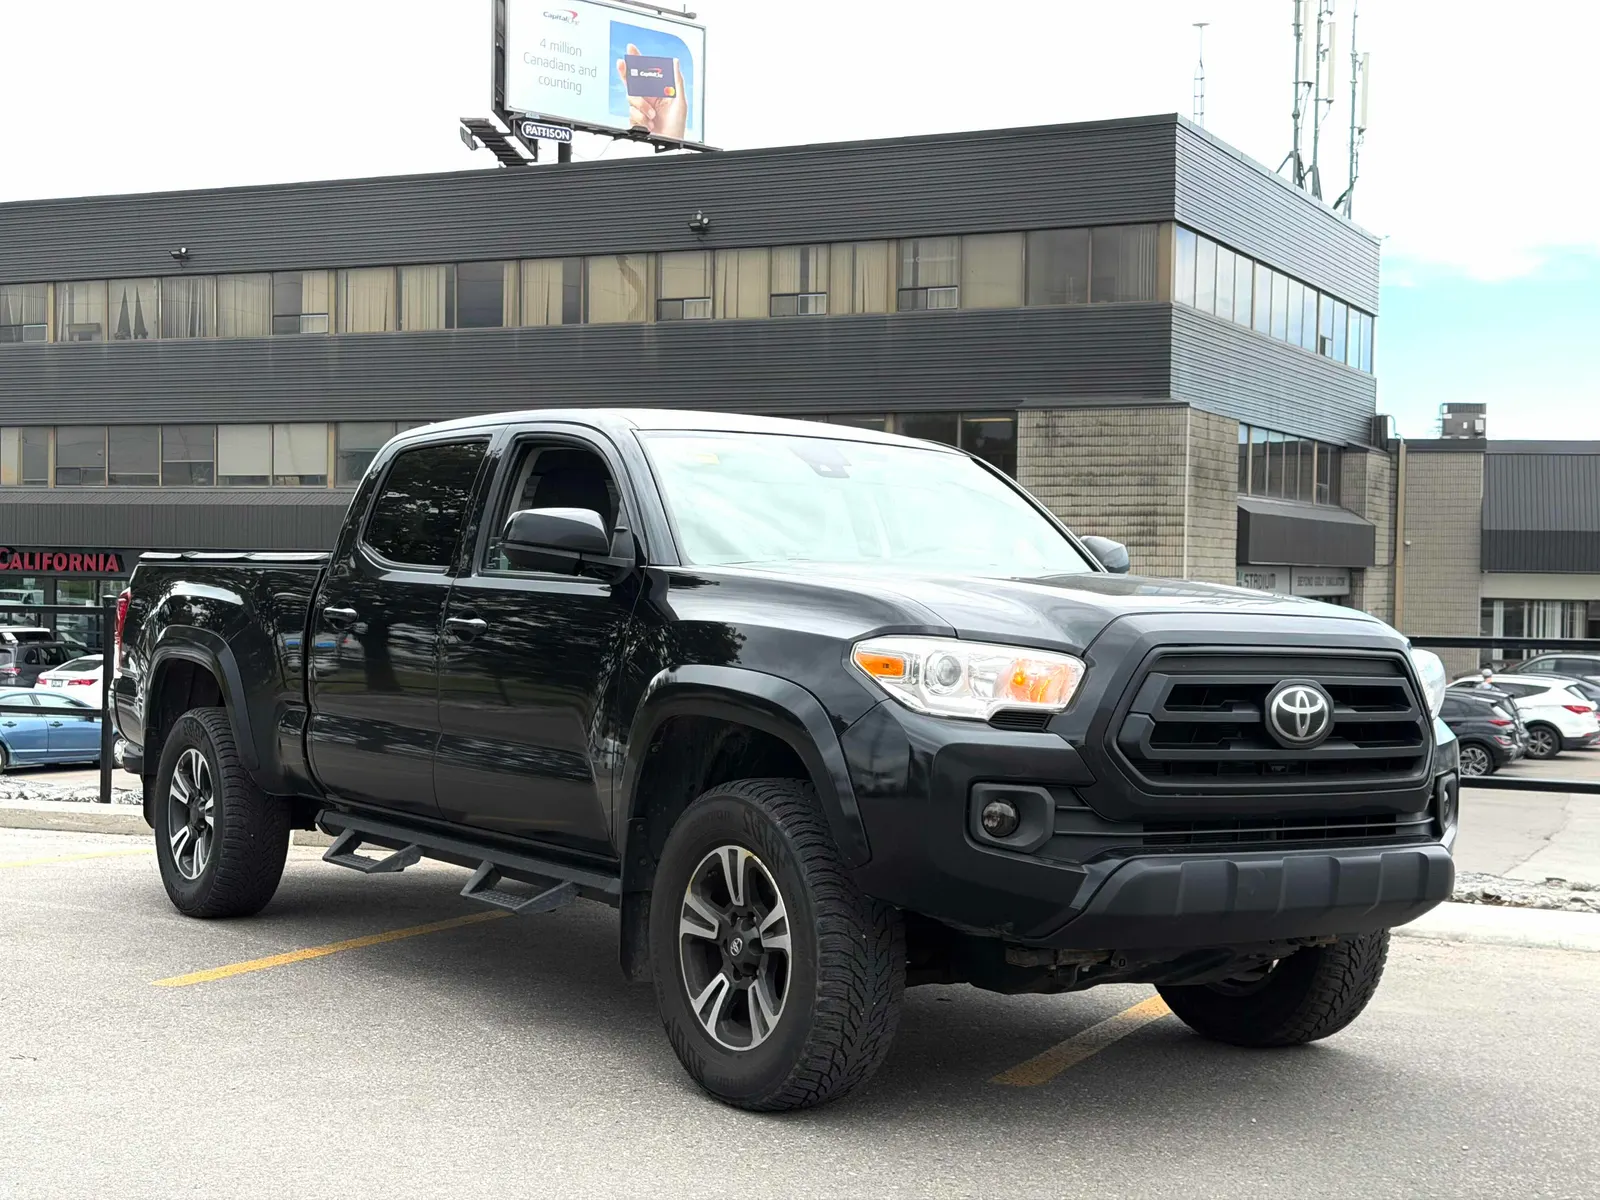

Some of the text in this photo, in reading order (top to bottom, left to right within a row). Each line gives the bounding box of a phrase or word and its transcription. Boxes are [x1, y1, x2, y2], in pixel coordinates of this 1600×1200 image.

[540, 38, 582, 57] 4 million
[523, 51, 598, 78] Canadians and
[538, 75, 582, 96] counting
[525, 124, 570, 141] PATTISON
[0, 546, 119, 572] CALIFORNIA
